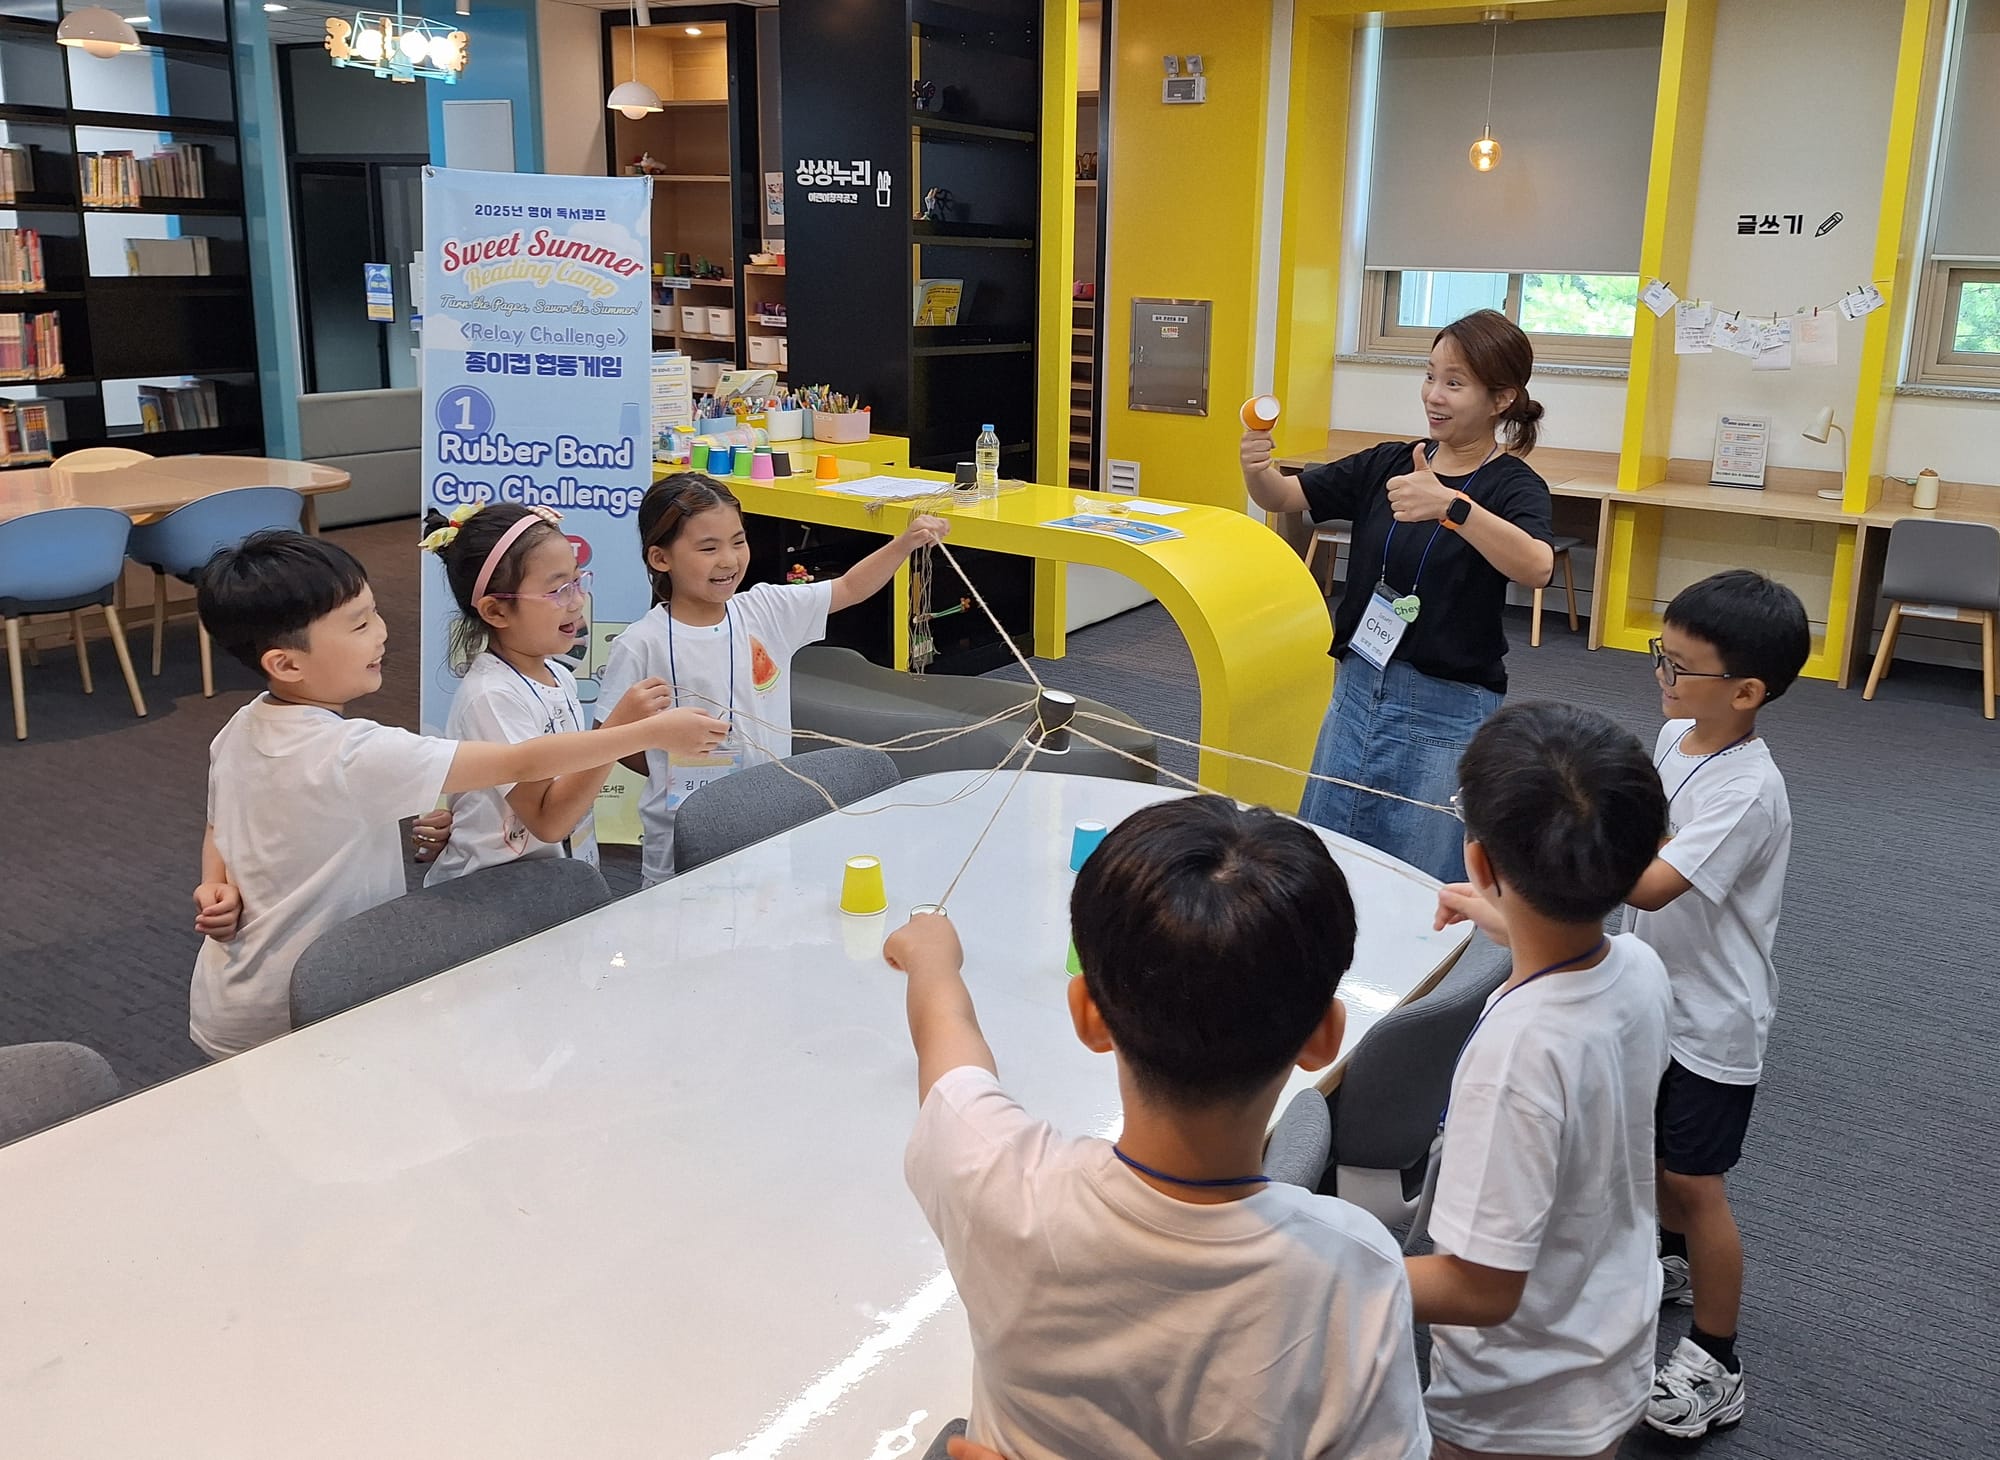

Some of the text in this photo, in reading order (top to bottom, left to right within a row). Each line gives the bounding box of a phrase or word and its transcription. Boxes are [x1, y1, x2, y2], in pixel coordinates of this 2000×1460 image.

[796, 160, 871, 186] 상상누리
[474, 204, 607, 221] 2025년 영어 독서캠프
[1737, 214, 1804, 235] 글쓰기
[443, 229, 644, 277] Sweet Summer
[465, 259, 617, 297] Reading Camp
[440, 293, 642, 317] Turn the Pages, Savor the Summer!
[460, 321, 628, 349] <Relay Challenge>
[465, 351, 622, 378] 종이컵 협동게임
[454, 395, 476, 430] 1
[438, 430, 633, 469] Rubber Band
[433, 472, 644, 518] Cup Challenge
[1366, 617, 1395, 645] Chey
